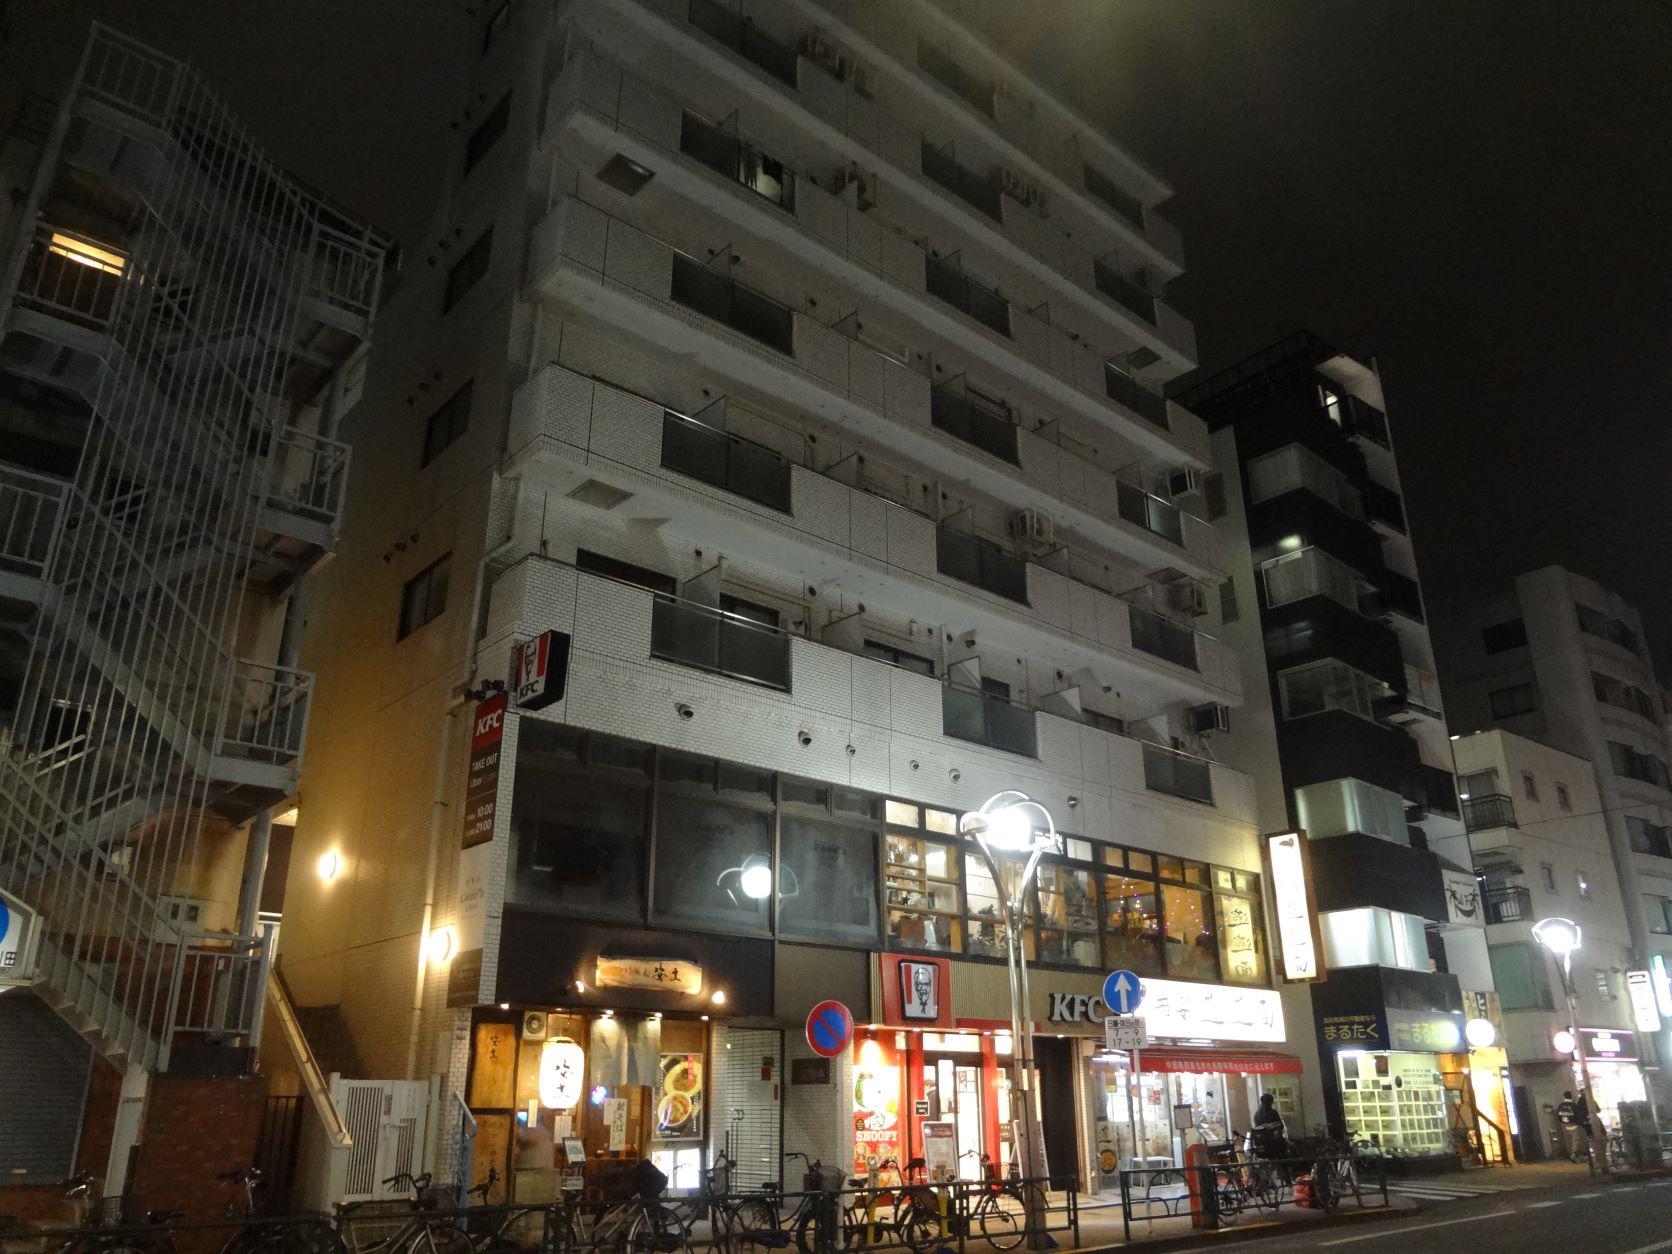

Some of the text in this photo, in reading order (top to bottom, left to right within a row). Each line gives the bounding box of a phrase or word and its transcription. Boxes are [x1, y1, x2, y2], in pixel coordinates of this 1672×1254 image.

[519, 680, 540, 700] KFC
[476, 709, 502, 736] KFC
[472, 753, 498, 771] TAKE OUT
[1051, 992, 1106, 1022] KFC
[1324, 1023, 1379, 1040] まるたく
[856, 1131, 897, 1142] SNOOPY
